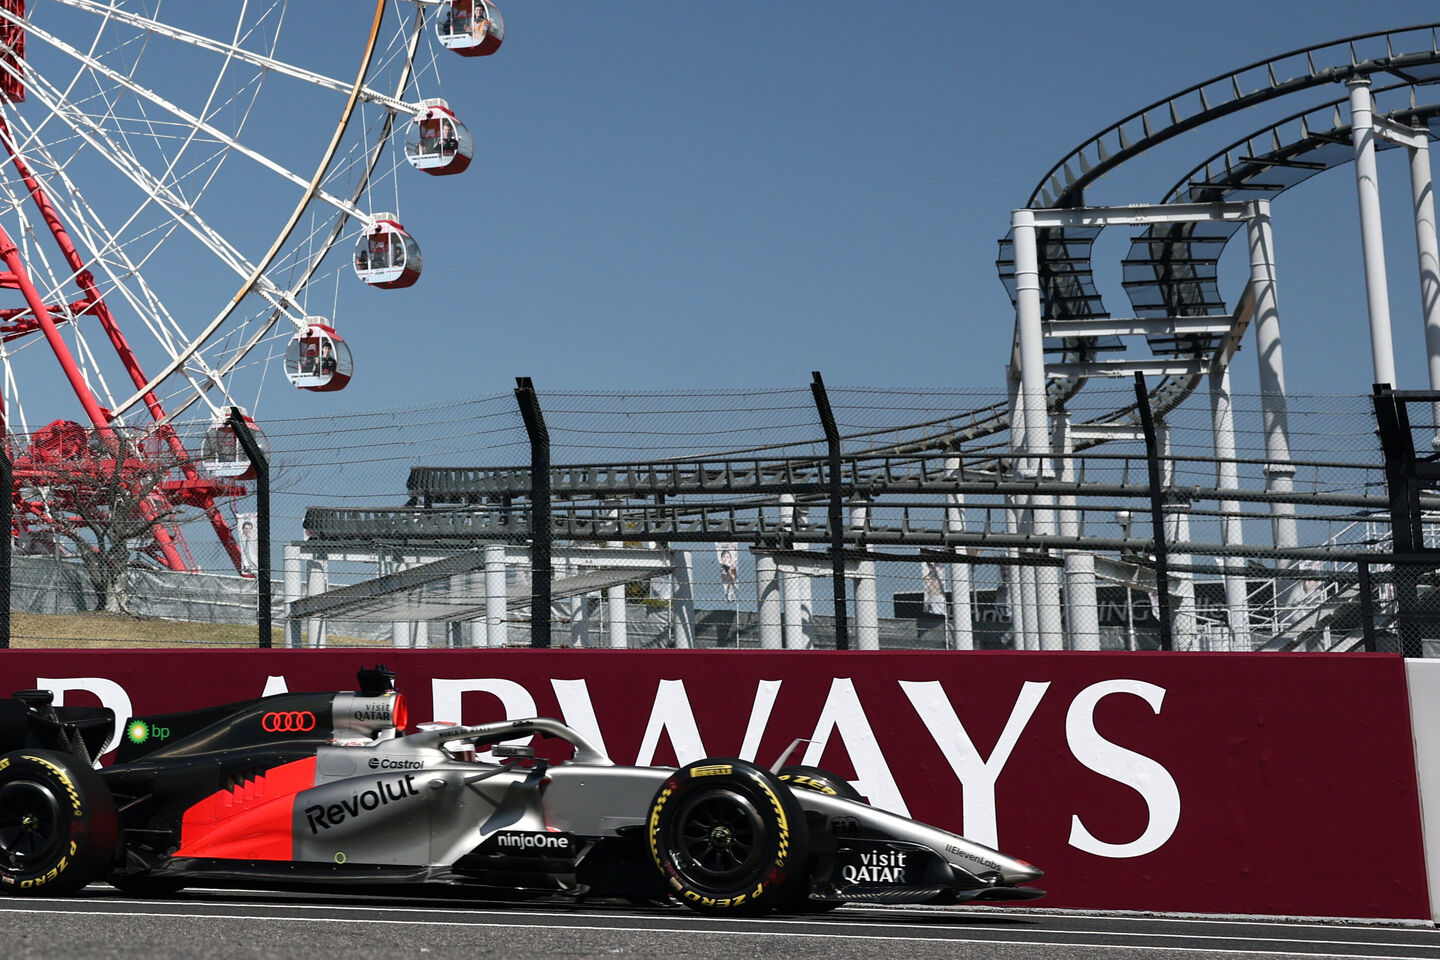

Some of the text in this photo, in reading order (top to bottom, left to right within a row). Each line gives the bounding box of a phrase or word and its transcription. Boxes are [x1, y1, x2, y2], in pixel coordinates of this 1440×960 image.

[365, 702, 390, 712] visit
[354, 711, 391, 722] QATAR
[152, 723, 170, 741] bp
[380, 759, 425, 770] Castrol
[792, 775, 838, 796] ZER
[304, 774, 420, 835] Revolut
[69, 839, 78, 856] P
[497, 833, 569, 850] ninjaOne
[860, 850, 907, 867] visit
[20, 856, 69, 888] ZERO
[842, 865, 907, 884] QATAR
[684, 882, 764, 908] P ZERO
